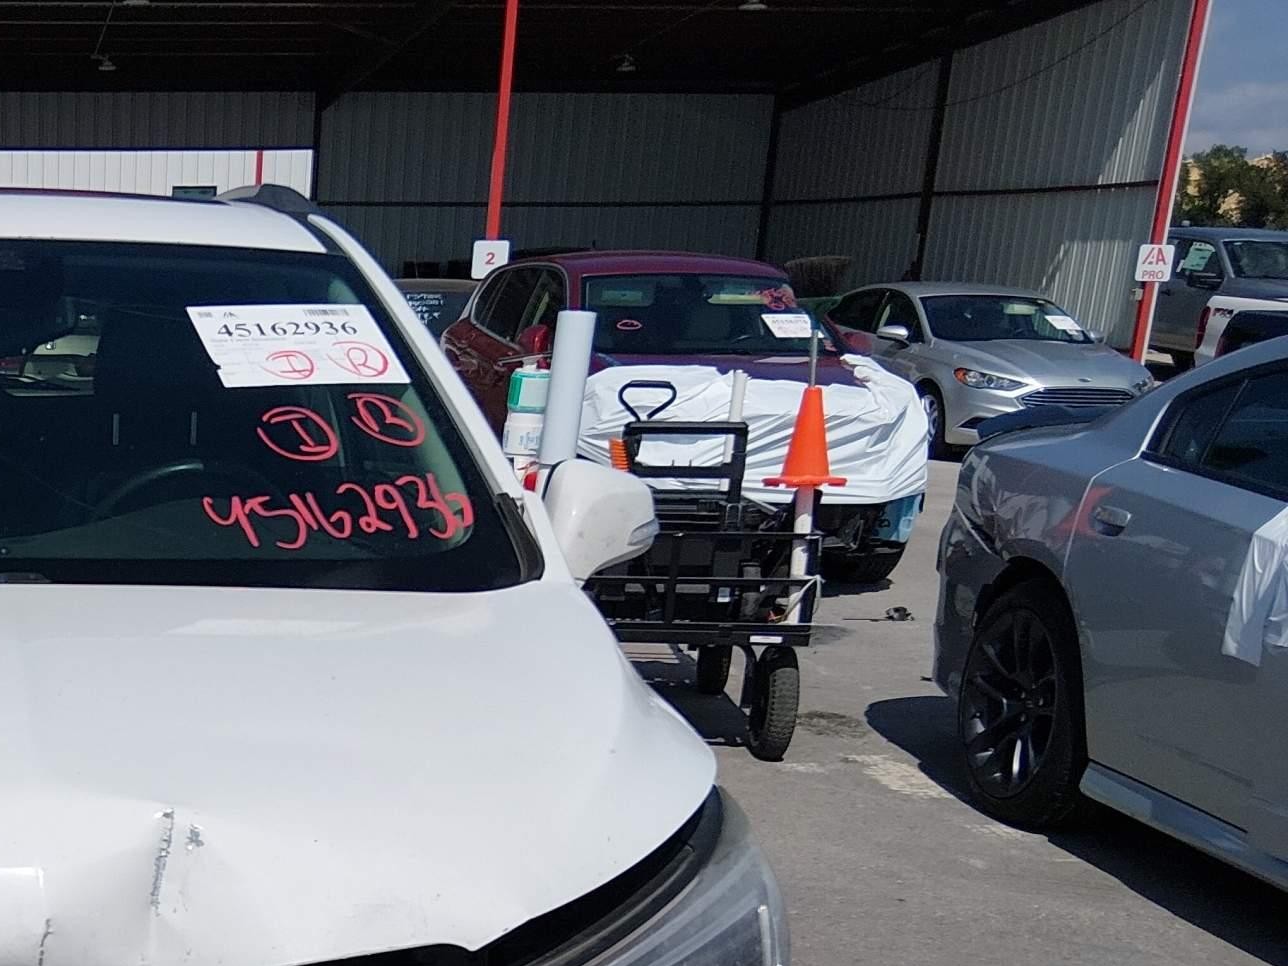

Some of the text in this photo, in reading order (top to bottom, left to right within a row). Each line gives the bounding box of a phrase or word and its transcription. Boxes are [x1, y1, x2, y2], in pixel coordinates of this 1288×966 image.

[485, 252, 496, 265] 2
[1142, 270, 1164, 280] PRO
[217, 320, 358, 338] 45162936
